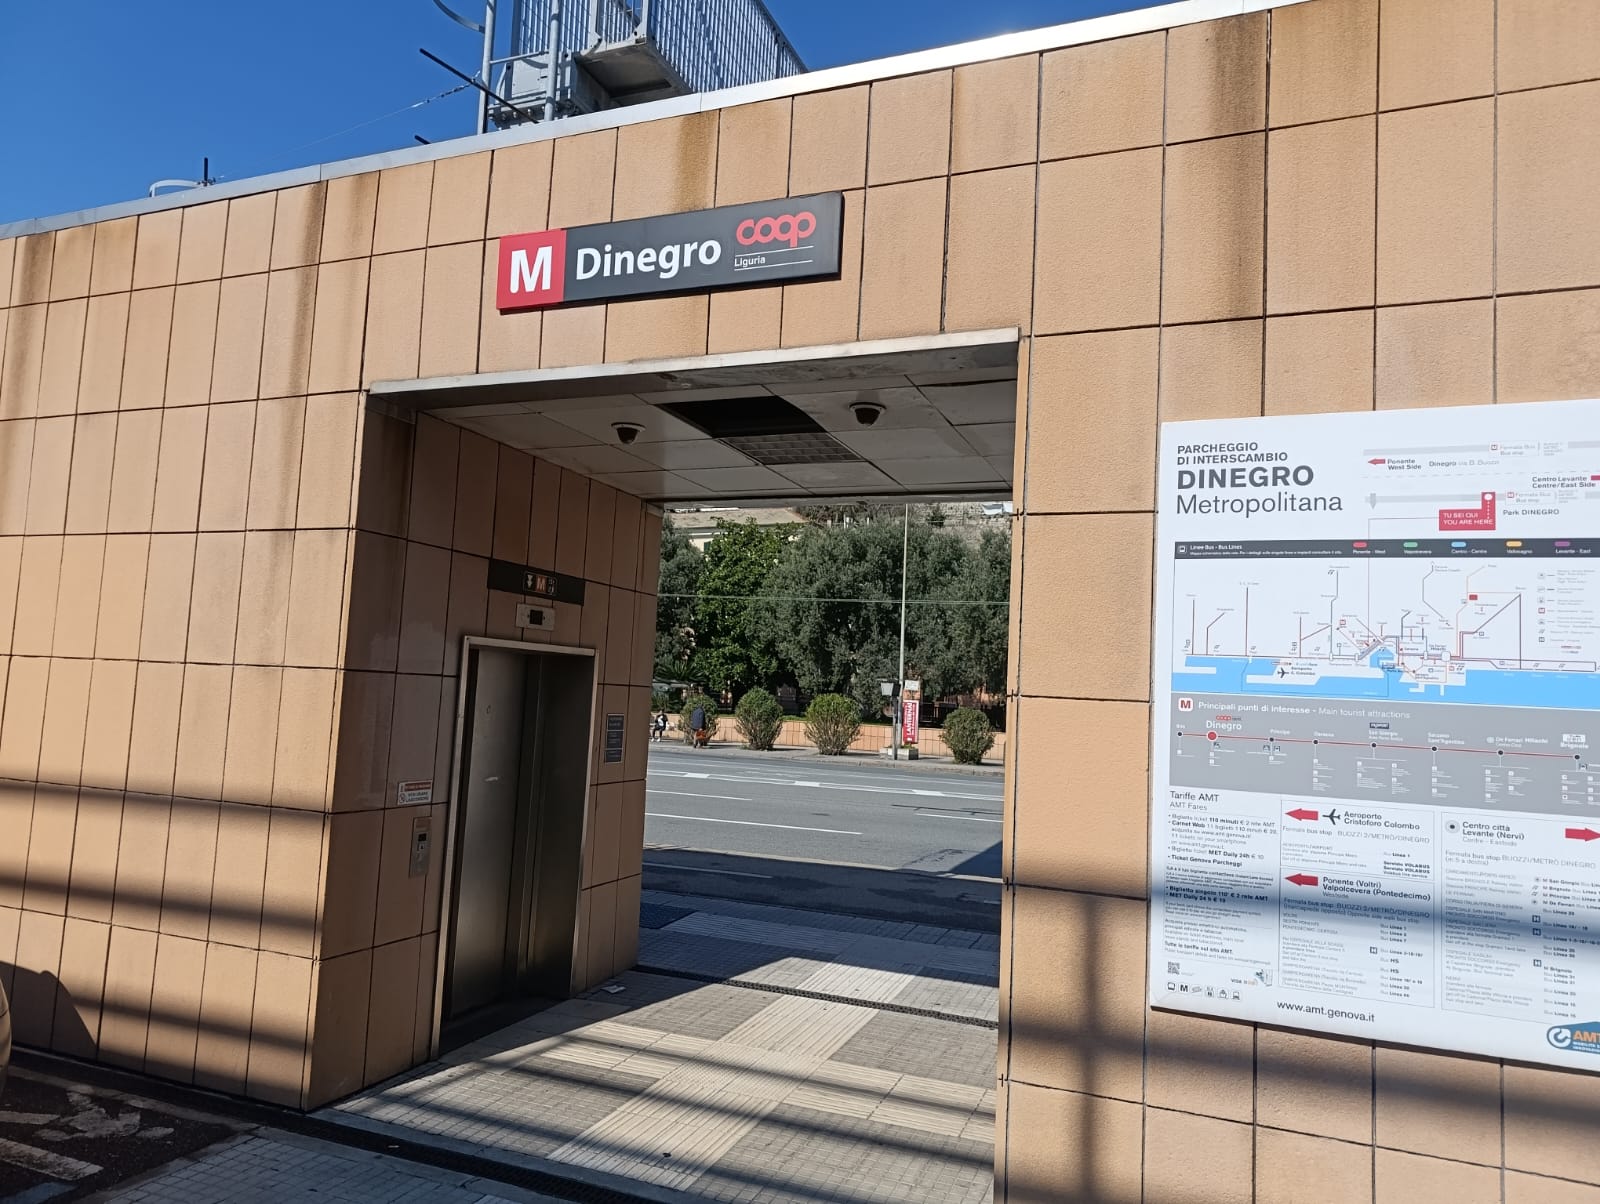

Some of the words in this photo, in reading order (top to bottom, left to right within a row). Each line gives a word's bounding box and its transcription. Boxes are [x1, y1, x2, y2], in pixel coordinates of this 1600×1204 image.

[735, 211, 817, 249] coop
[509, 246, 553, 294] M
[575, 239, 722, 281] Dinegro
[734, 255, 766, 268] Liguria
[1177, 442, 1258, 454] PARCHEGGIO
[1177, 456, 1190, 465] DI
[1193, 452, 1288, 465] INTERSCAMBIO
[1177, 465, 1314, 489] DINEGRO
[1176, 491, 1343, 518] Metropolitana
[1180, 700, 1191, 708] M
[1198, 701, 1235, 711] Principali
[1238, 704, 1258, 712] punti
[1271, 705, 1310, 714] interesse
[1318, 707, 1337, 715] Main
[1205, 720, 1242, 731] Dinegro
[1169, 791, 1196, 800] Tariffe
[1198, 793, 1220, 802] AMT
[1344, 811, 1382, 821] Aeroporto
[1344, 818, 1382, 827] Cristoforo
[1384, 820, 1420, 830] Colombo
[1462, 821, 1490, 830] Centro
[1492, 823, 1511, 832] città
[1462, 829, 1494, 837] Levante
[1496, 831, 1525, 841] (Nervi)
[1323, 876, 1354, 886] Ponente
[1356, 878, 1381, 888] (Voltri)
[1322, 883, 1371, 895] Valpolcevera
[1373, 889, 1431, 901] (Pontedecimo)
[1277, 1000, 1375, 1022] www.amt.genova.it
